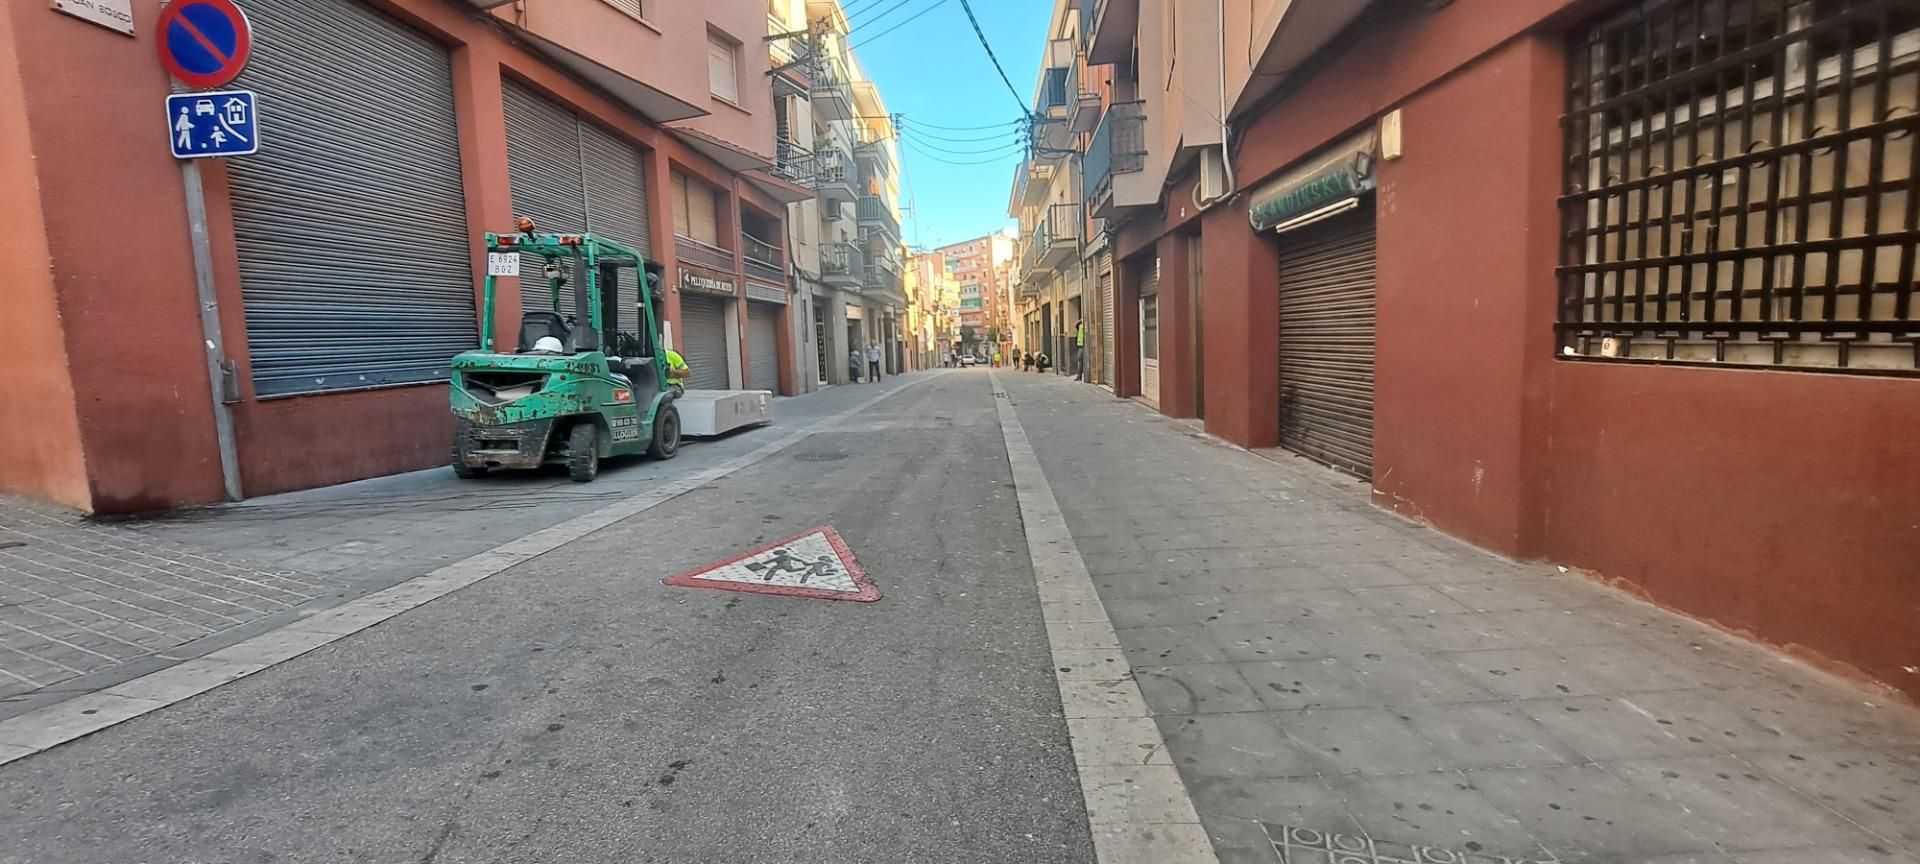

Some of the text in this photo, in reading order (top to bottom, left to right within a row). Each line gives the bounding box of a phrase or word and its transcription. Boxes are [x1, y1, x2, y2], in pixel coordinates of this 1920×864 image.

[68, 0, 131, 22] OAN BOSCO
[490, 255, 517, 264] E 6924
